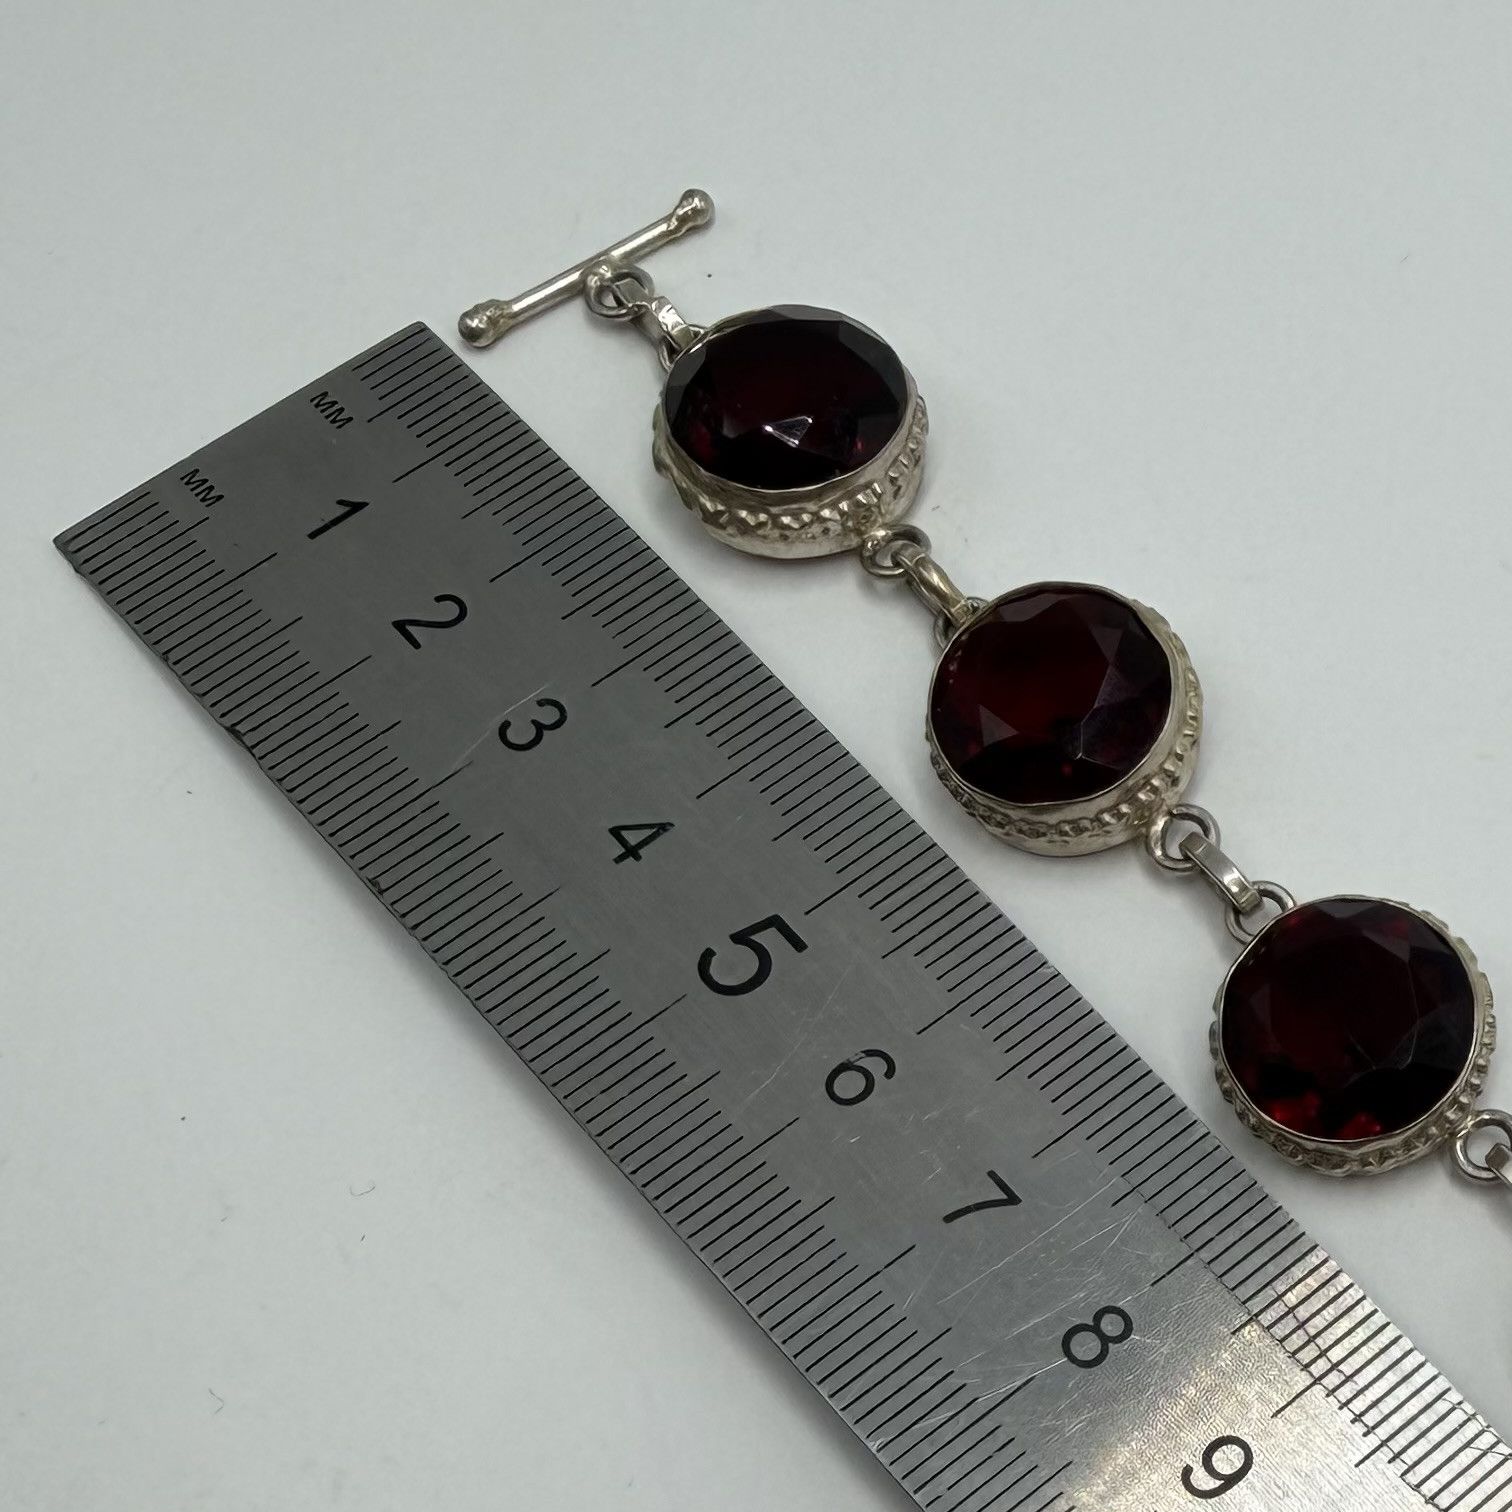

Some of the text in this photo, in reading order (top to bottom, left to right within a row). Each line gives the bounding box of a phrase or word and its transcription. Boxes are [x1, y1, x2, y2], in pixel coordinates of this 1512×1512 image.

[310, 391, 353, 429] MM
[180, 469, 224, 507] MM
[307, 499, 369, 540] 1
[392, 594, 467, 650] 2
[498, 698, 567, 751] 3
[608, 822, 675, 864] 4
[698, 914, 808, 996] 5
[825, 1049, 896, 1106] 6
[943, 1170, 1022, 1223] 7
[1061, 1306, 1133, 1369] 8
[1180, 1435, 1253, 1499] 9
